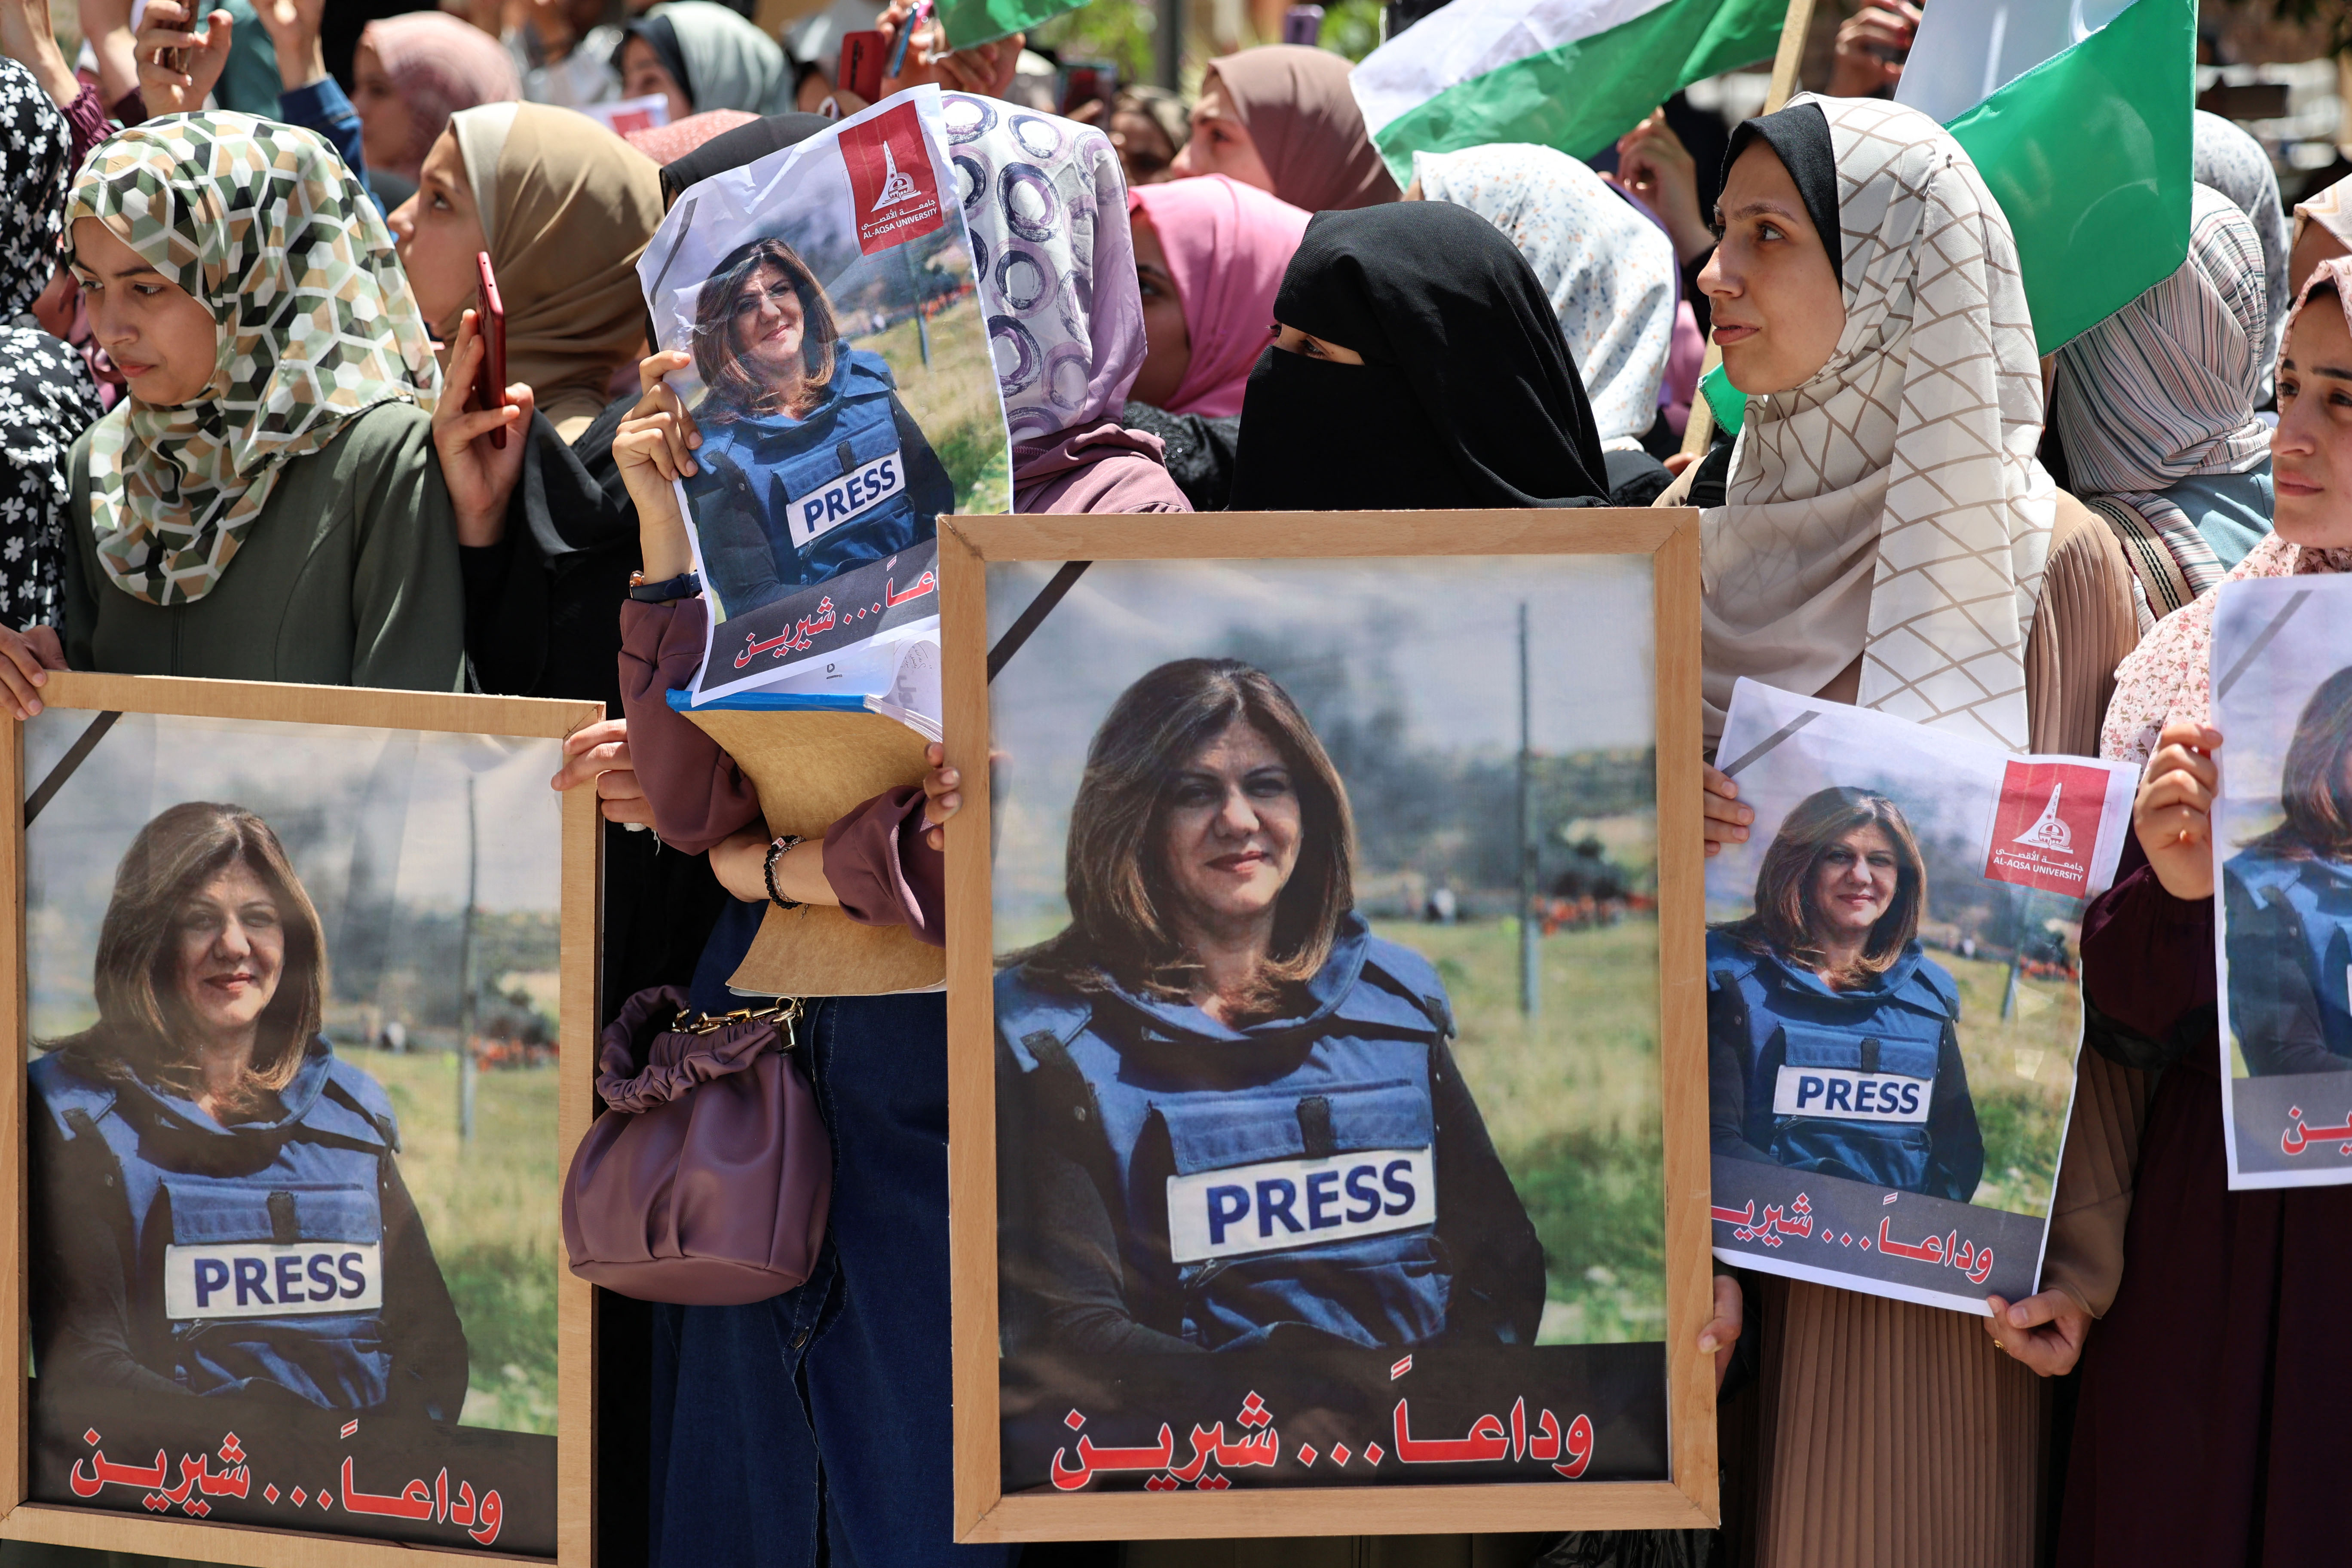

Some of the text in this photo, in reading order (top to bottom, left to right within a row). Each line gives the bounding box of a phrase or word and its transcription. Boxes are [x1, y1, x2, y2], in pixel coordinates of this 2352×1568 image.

[885, 148, 894, 171] 1955
[863, 207, 937, 239] AL-AQSA UNIVERSITY
[803, 459, 897, 533] PRESS
[733, 595, 836, 669] شيرين
[1993, 856, 2083, 882] AL-AQSA UNIVERSITY
[1796, 1075, 1920, 1115] PRESS
[1206, 1159, 1417, 1245] PRESS
[1711, 1192, 1813, 1248] شيري
[193, 1252, 366, 1308] PRESS
[70, 1428, 251, 1518] شيرين
